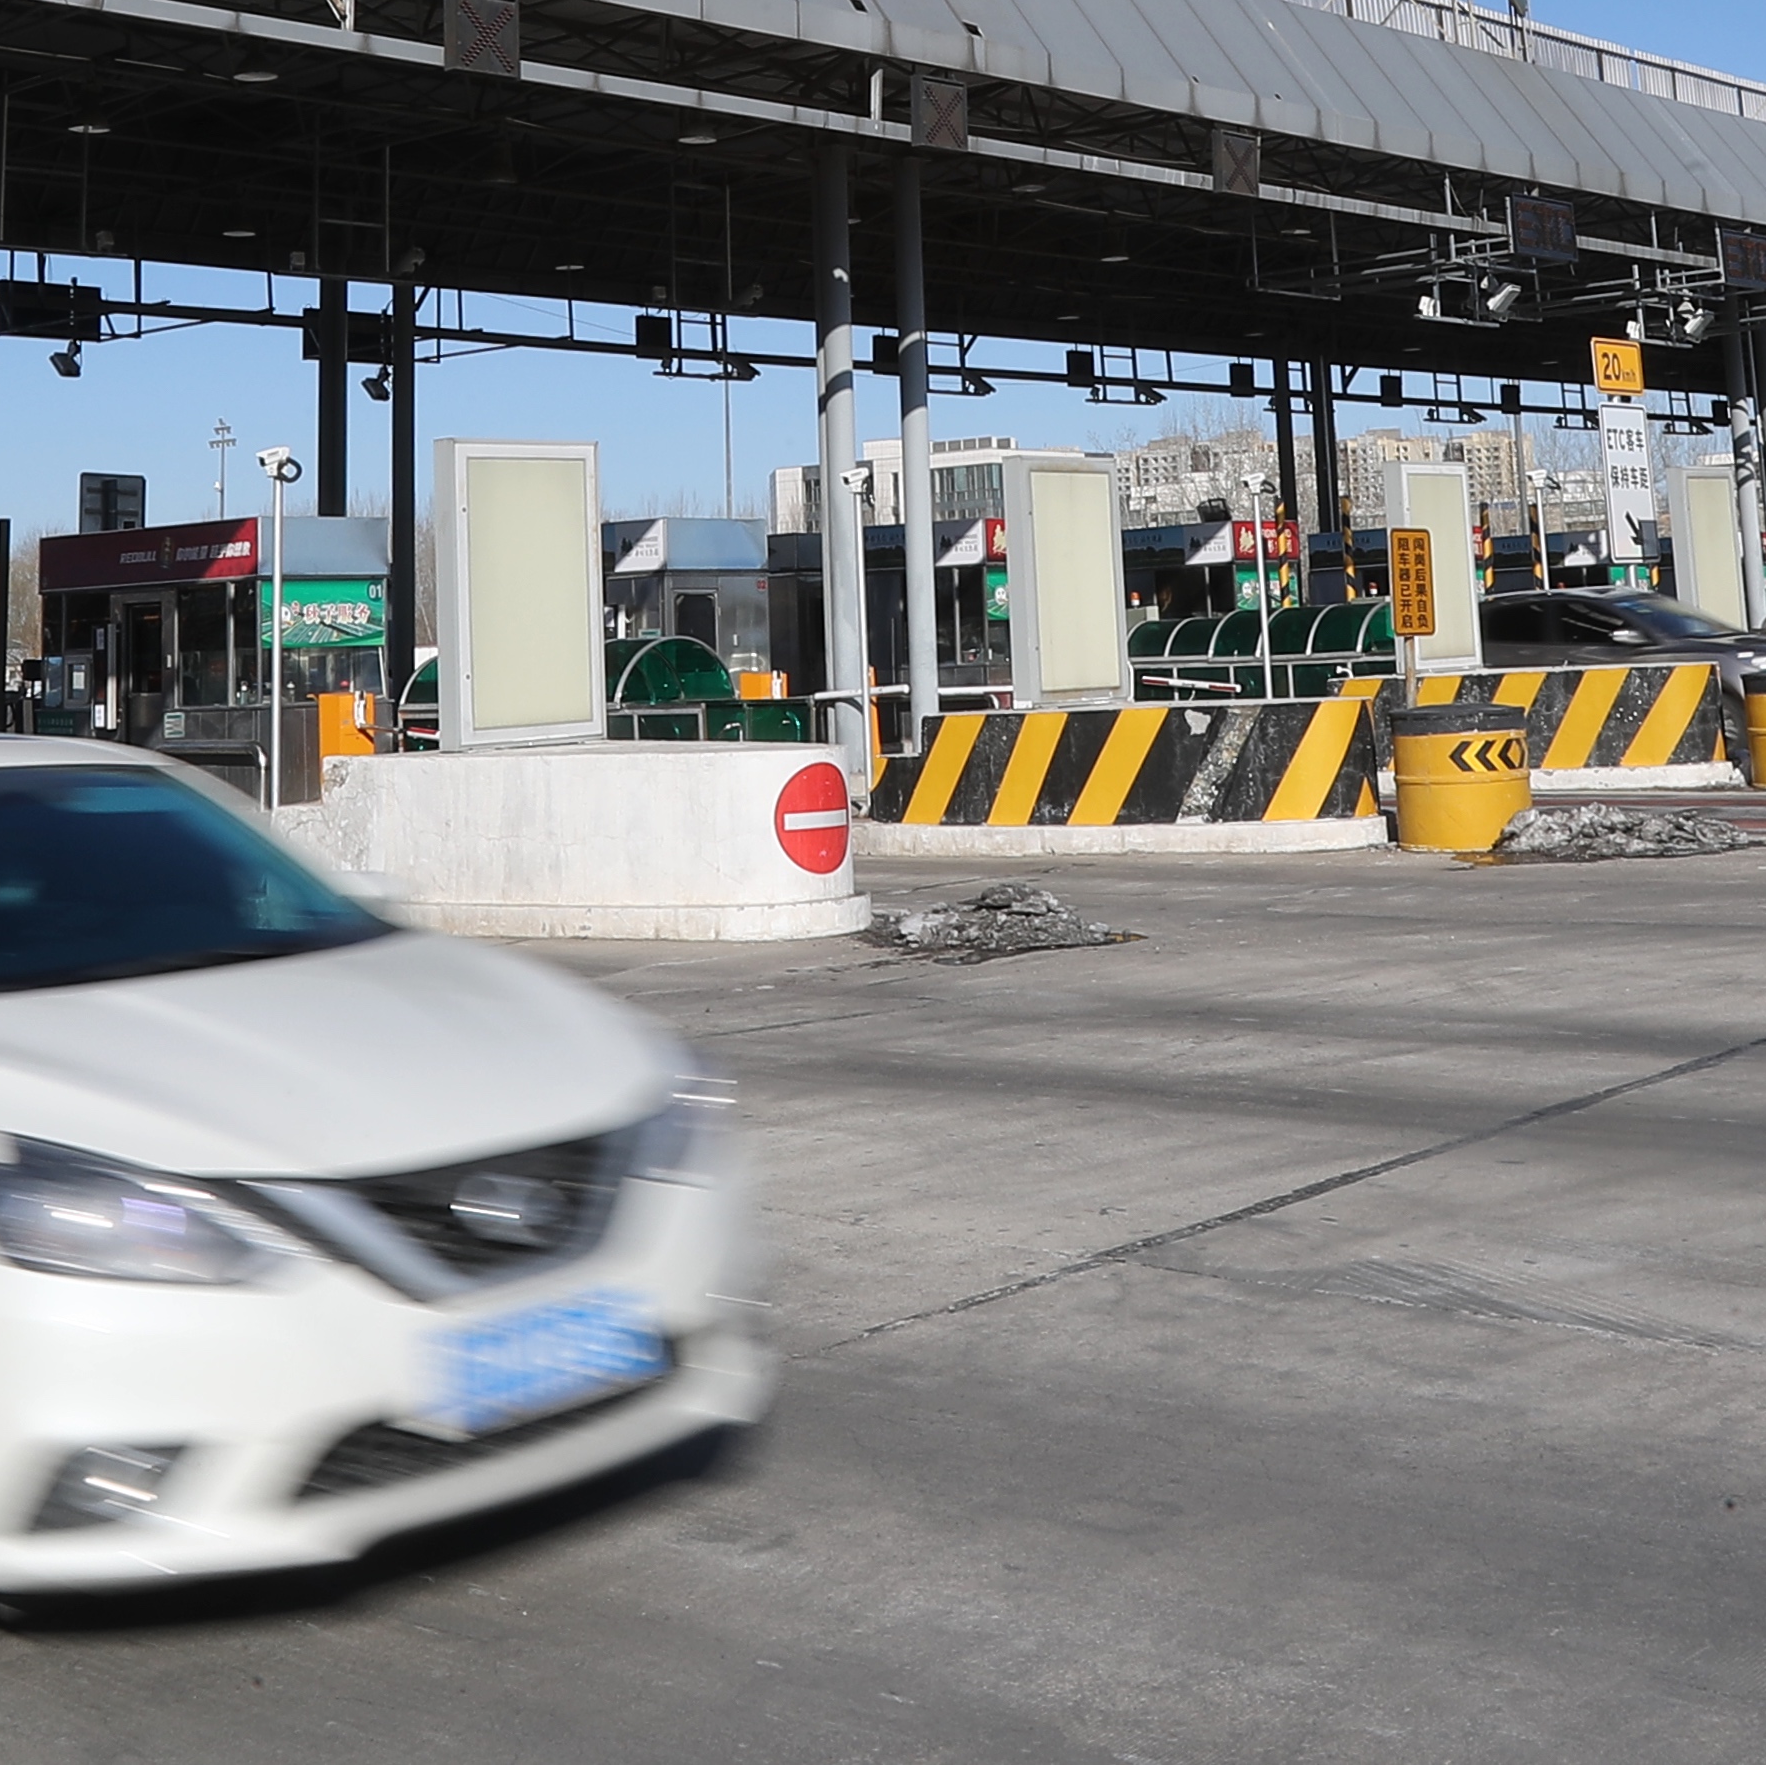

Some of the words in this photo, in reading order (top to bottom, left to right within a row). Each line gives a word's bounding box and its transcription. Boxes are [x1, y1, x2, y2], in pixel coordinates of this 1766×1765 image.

[1606, 427, 1645, 453] ETC客车
[368, 584, 382, 599] 01
[1397, 537, 1414, 629] 阻车器已开启
[1413, 537, 1429, 629] 闯岗后果自负
